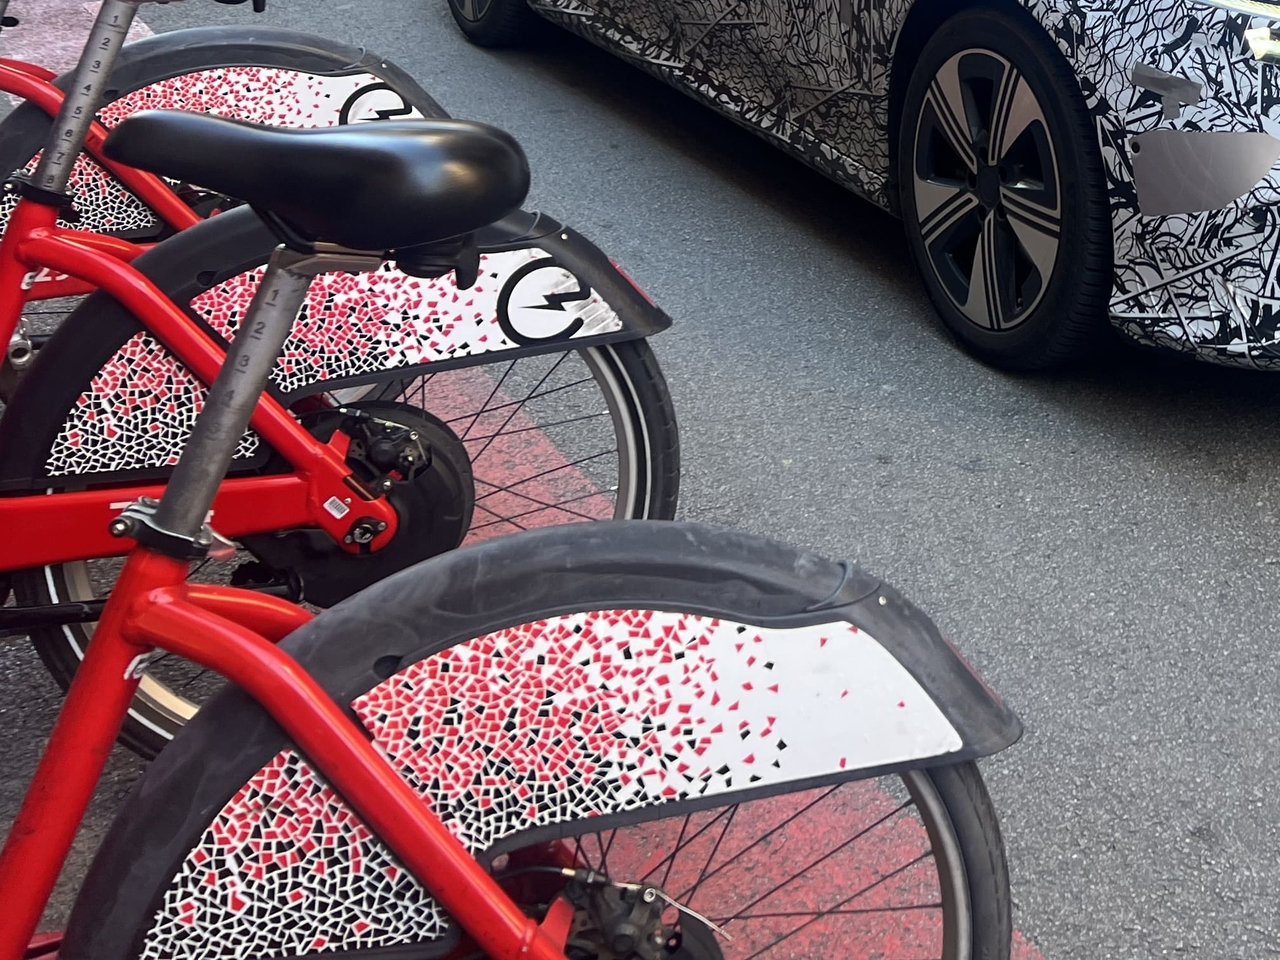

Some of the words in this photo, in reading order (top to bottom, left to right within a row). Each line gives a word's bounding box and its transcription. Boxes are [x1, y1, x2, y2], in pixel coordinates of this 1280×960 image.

[103, 37, 111, 46] 2
[92, 60, 101, 69] 3
[84, 83, 92, 92] 4
[74, 106, 83, 115] 5
[57, 152, 65, 162] 7
[255, 321, 266, 335] 2
